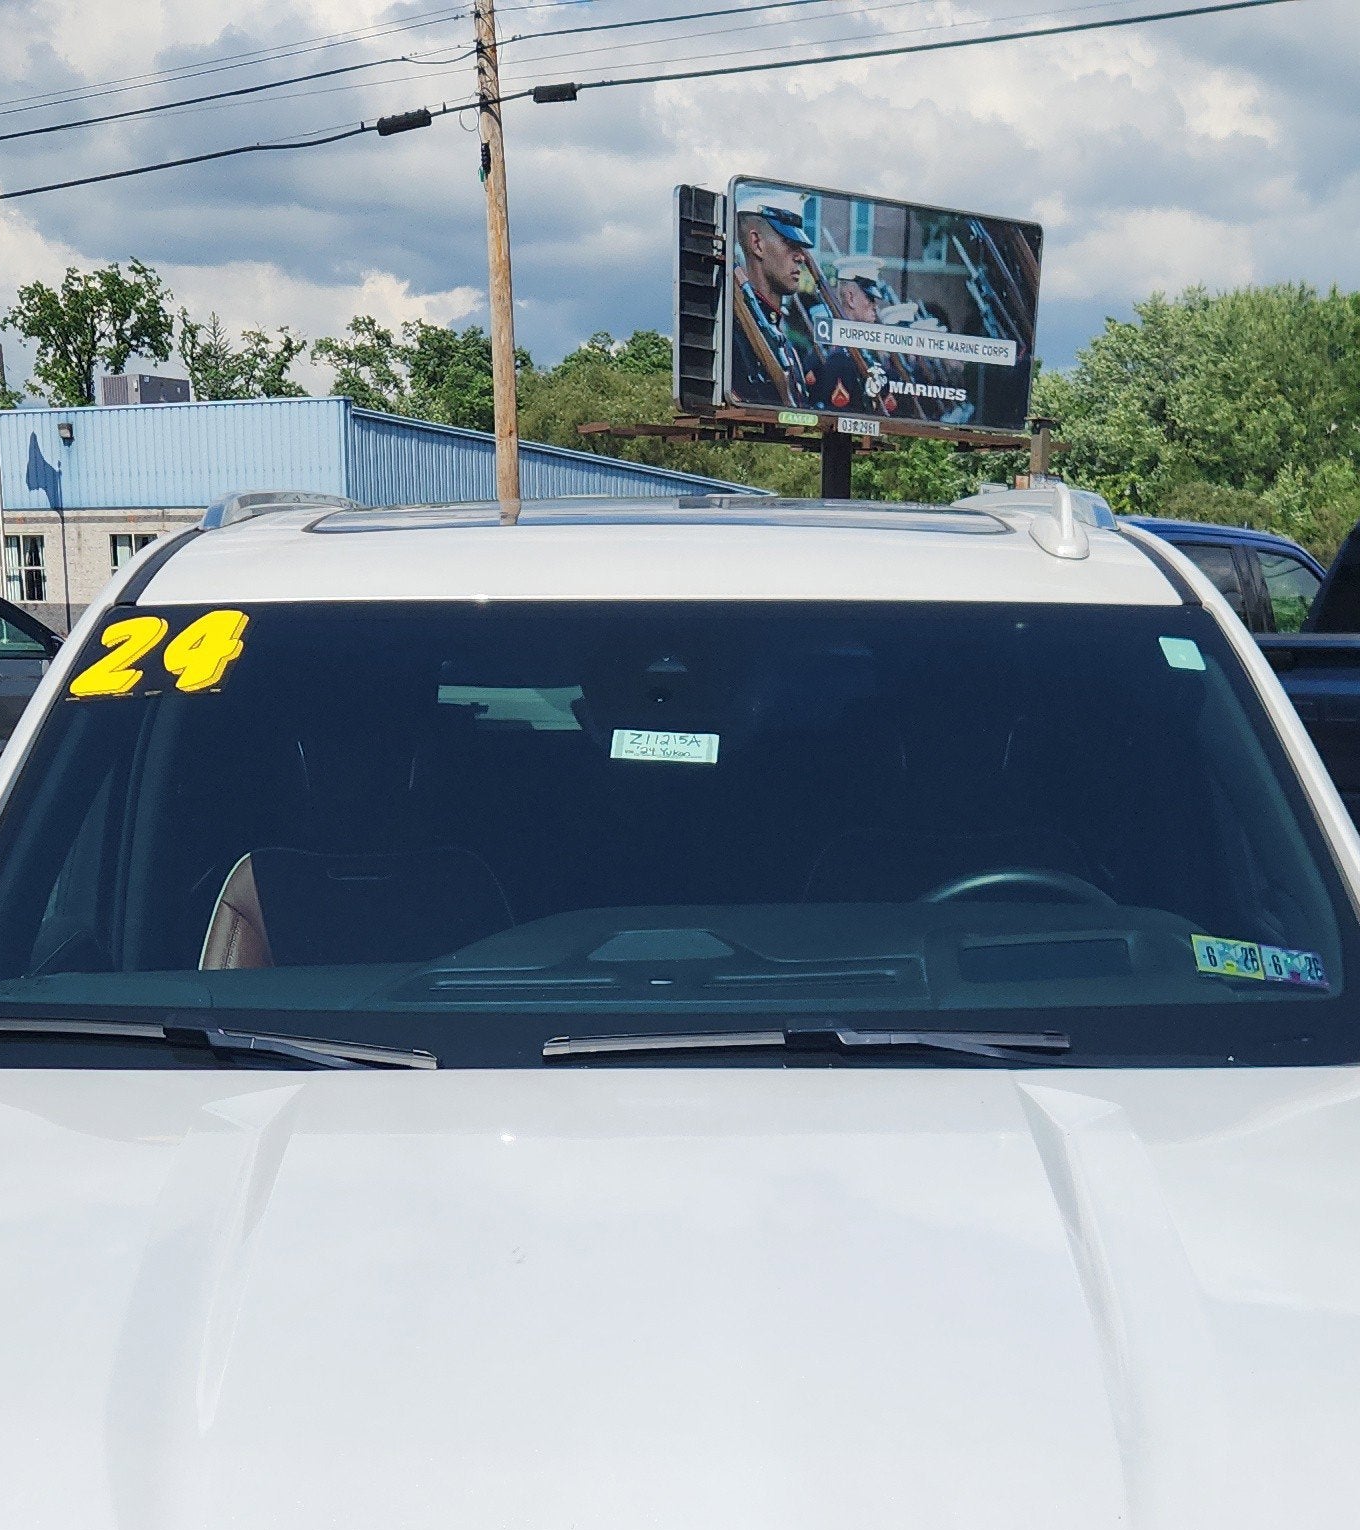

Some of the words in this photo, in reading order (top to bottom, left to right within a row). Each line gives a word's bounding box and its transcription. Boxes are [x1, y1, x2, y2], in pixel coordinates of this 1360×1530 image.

[839, 327, 881, 343] PURPOSE
[884, 332, 913, 347] FOUND
[915, 335, 925, 347] IN
[928, 337, 944, 350] THE
[947, 340, 980, 355] MARINE
[982, 344, 1009, 358] CORPS
[889, 381, 967, 402] MARINES
[69, 609, 250, 697] 24
[629, 732, 701, 747] Z11215A
[1206, 945, 1218, 968] 6
